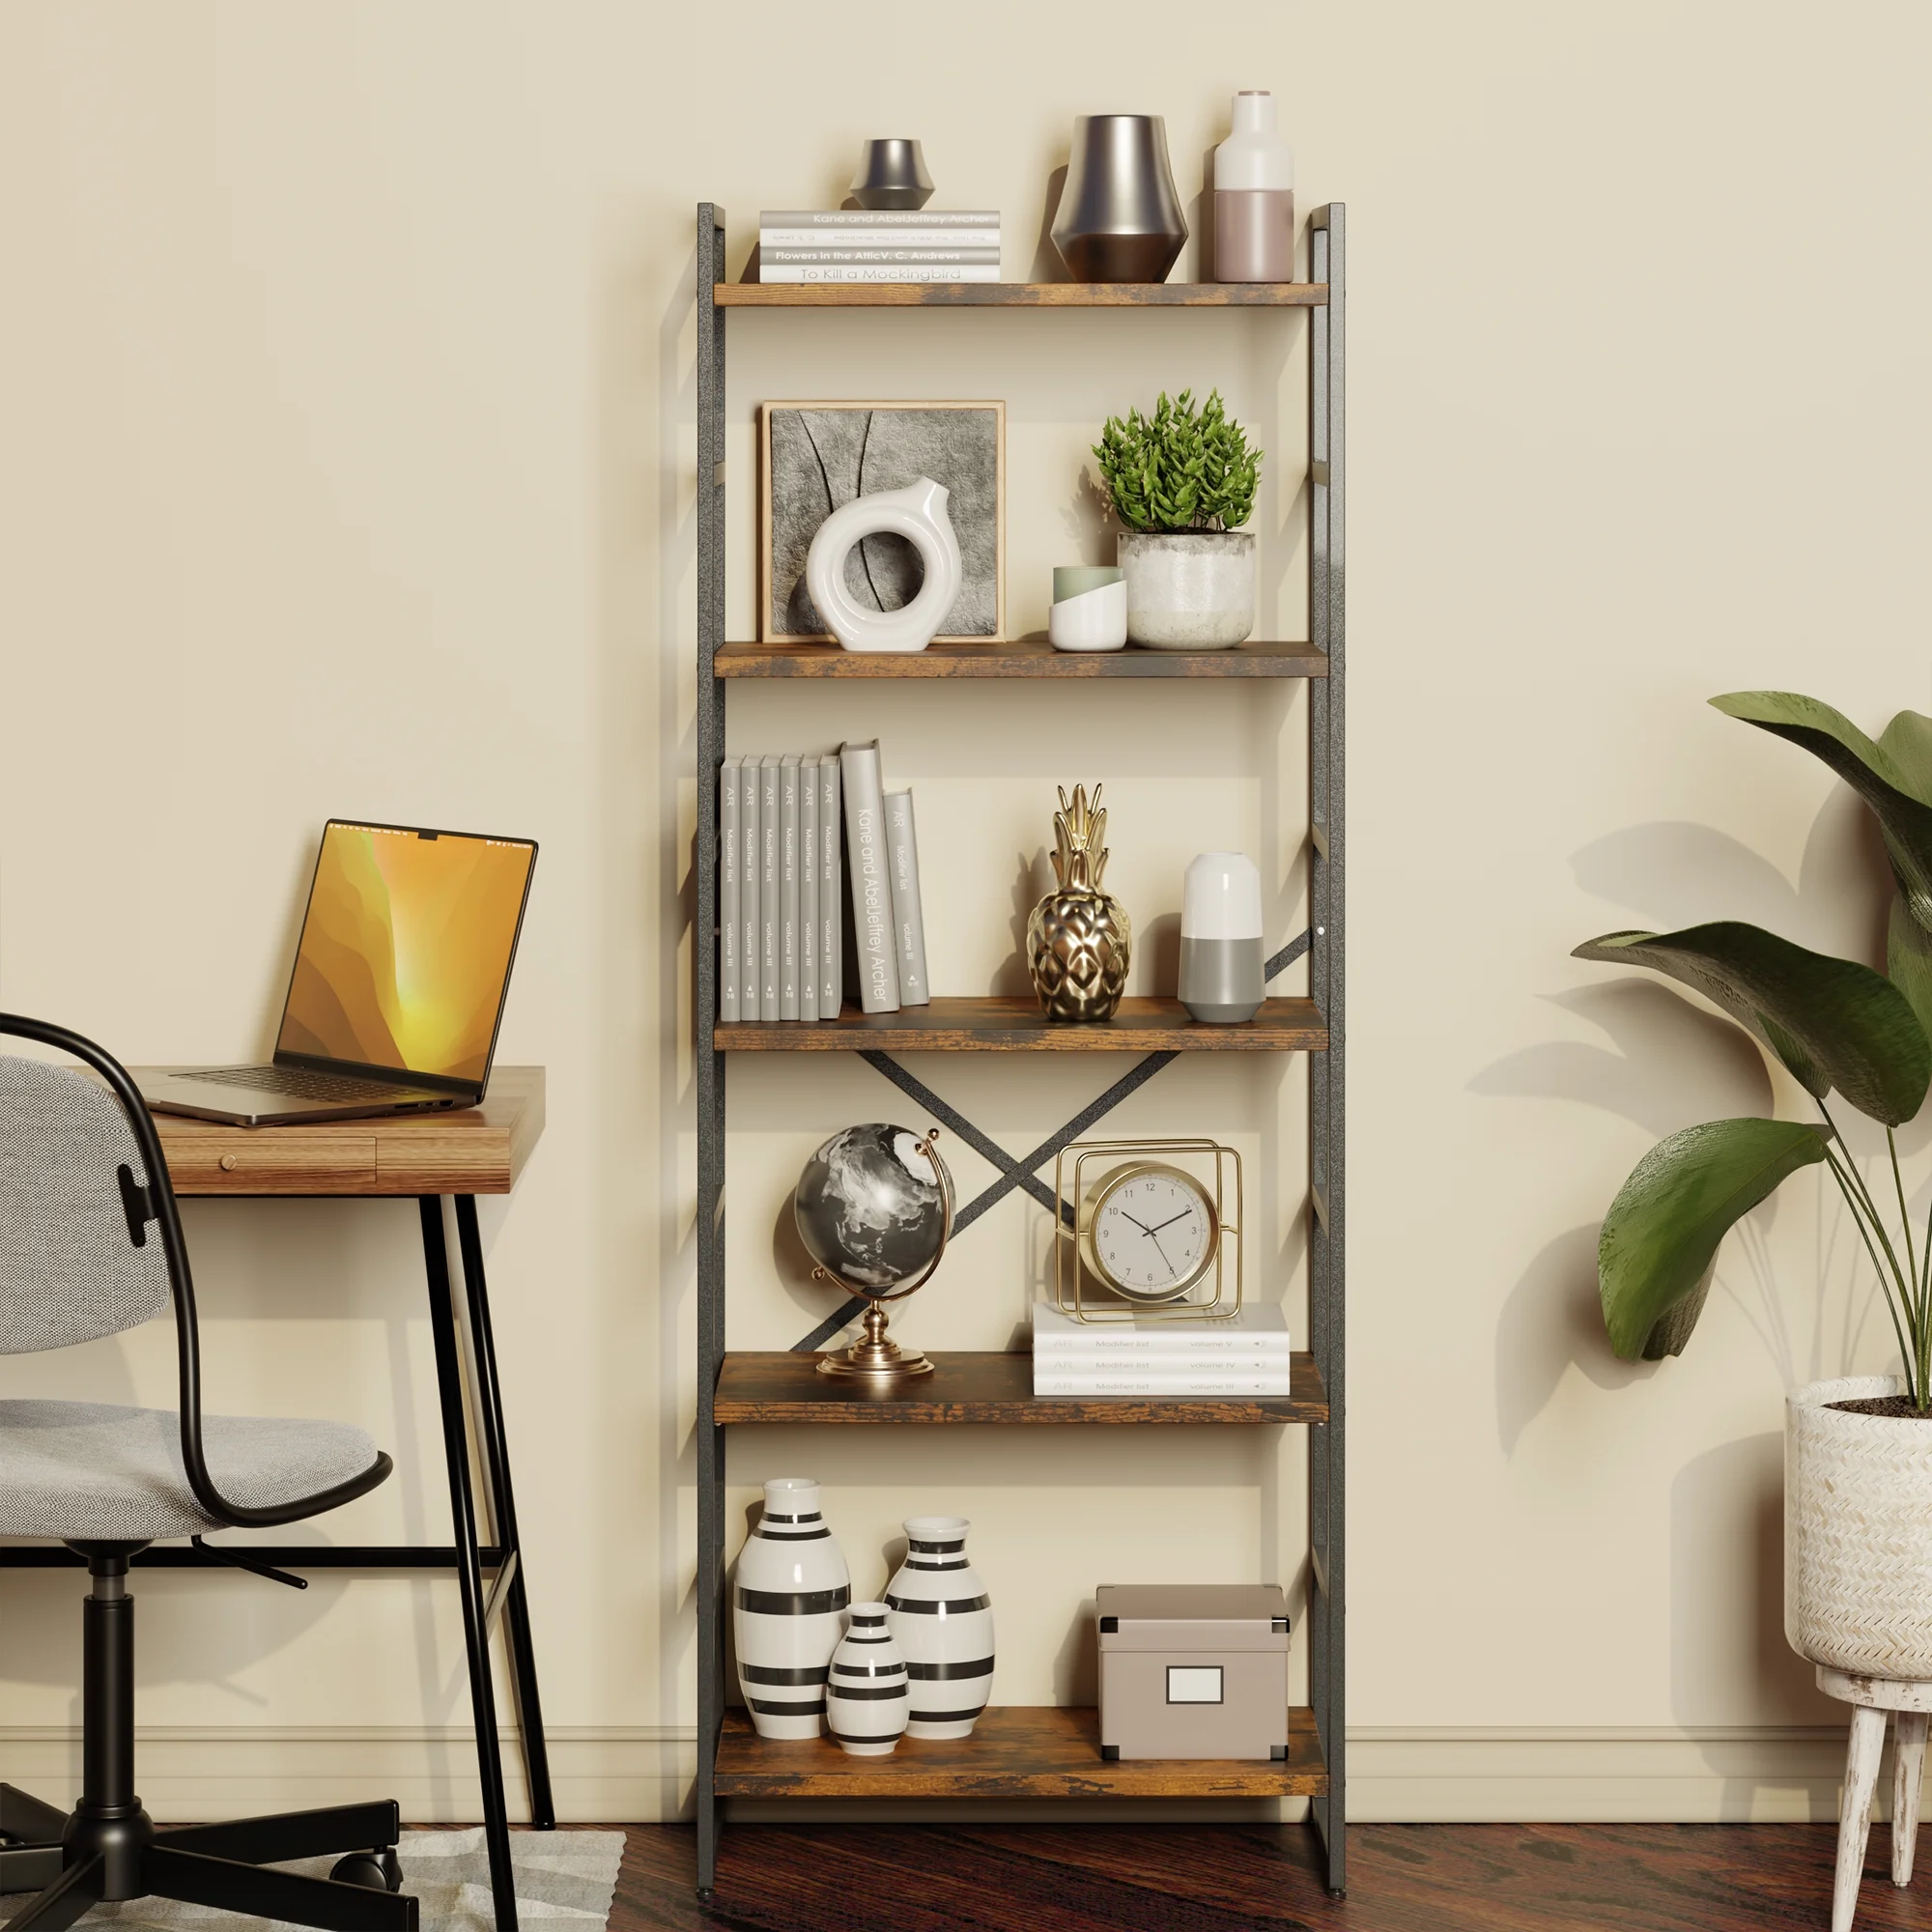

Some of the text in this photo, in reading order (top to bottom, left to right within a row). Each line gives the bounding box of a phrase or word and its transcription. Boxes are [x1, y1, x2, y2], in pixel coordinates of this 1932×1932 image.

[813, 214, 845, 223] Kane
[849, 214, 874, 223] and
[776, 251, 817, 260] Flowers
[820, 251, 831, 260] in
[834, 251, 852, 260] the
[895, 251, 908, 260] C.
[911, 251, 960, 260] Andrews
[801, 269, 817, 279] To
[823, 269, 842, 279] Kill
[863, 269, 961, 281] Mockingbird
[726, 787, 734, 807] AR
[746, 786, 753, 806] AR
[766, 786, 774, 806] AR
[785, 785, 793, 805] AR
[806, 786, 813, 806] AR
[825, 783, 833, 803] AR
[858, 809, 873, 843] Kane
[893, 810, 904, 827] AR
[862, 847, 879, 874] and
[895, 845, 908, 890] Modifier list
[903, 923, 913, 951] volume
[870, 957, 888, 1001] Archer
[1185, 1205, 1191, 1213] 2
[1110, 1252, 1116, 1261] 8
[1147, 1273, 1153, 1282] 6
[1169, 1266, 1175, 1275] 5
